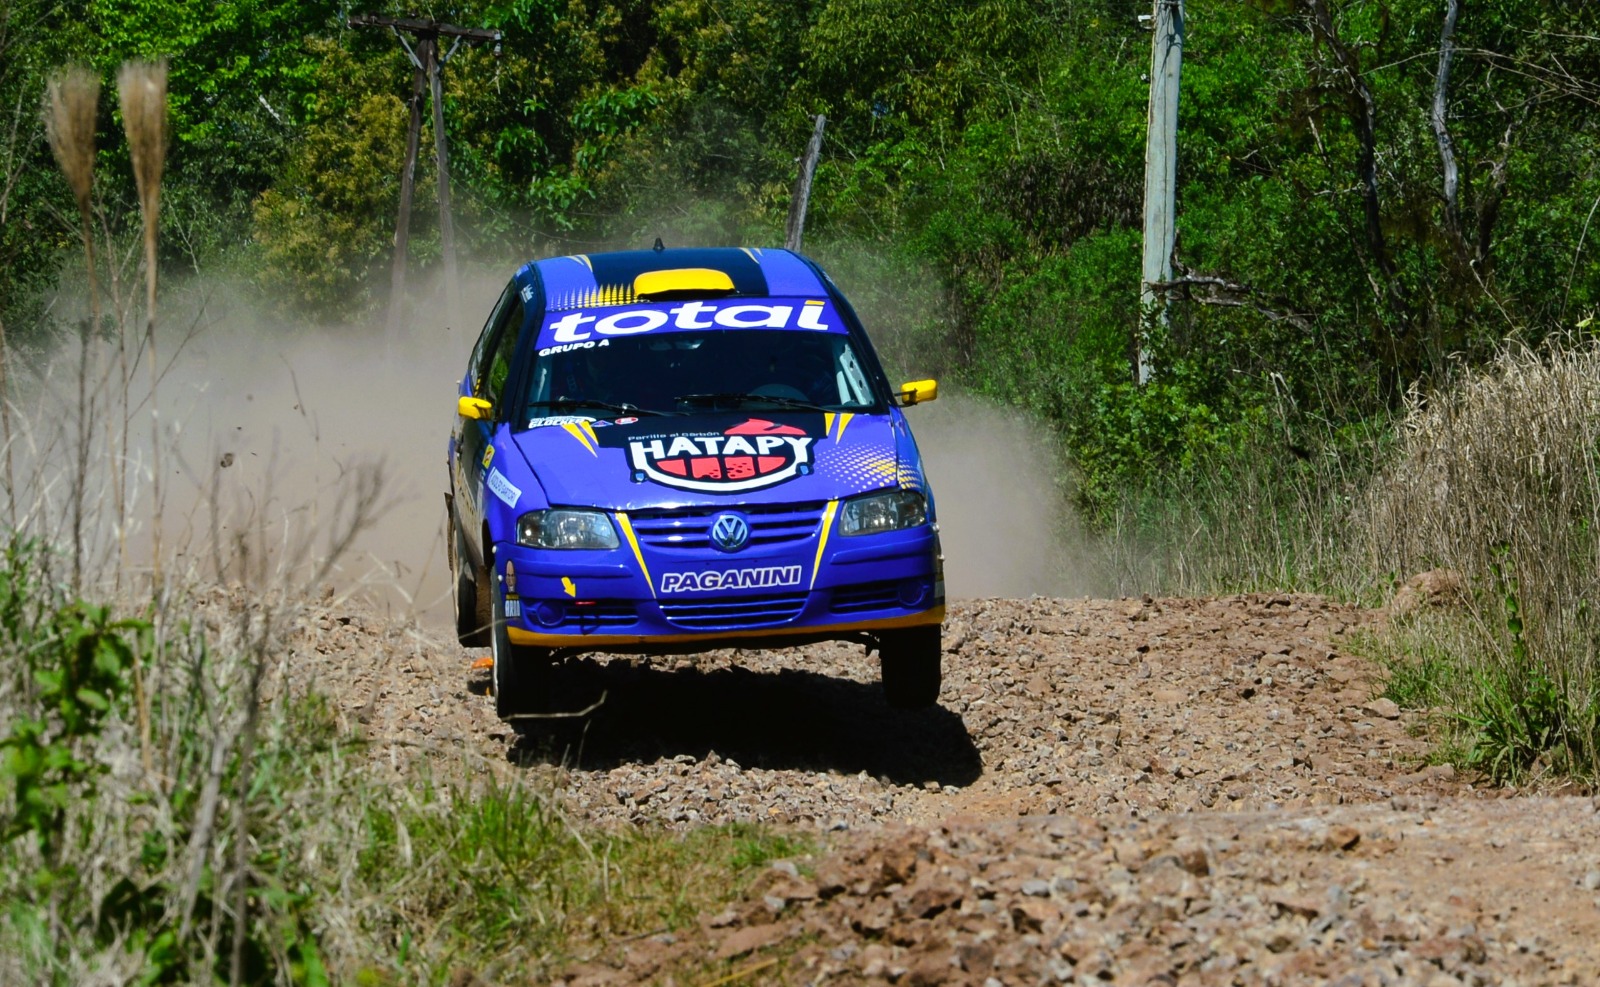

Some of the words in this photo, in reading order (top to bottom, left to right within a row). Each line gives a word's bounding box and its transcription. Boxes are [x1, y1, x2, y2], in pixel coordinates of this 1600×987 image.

[538, 340, 596, 357] GRUPO
[598, 338, 610, 348] A
[629, 435, 813, 461] HATAPY
[660, 564, 803, 594] PAGANINI
